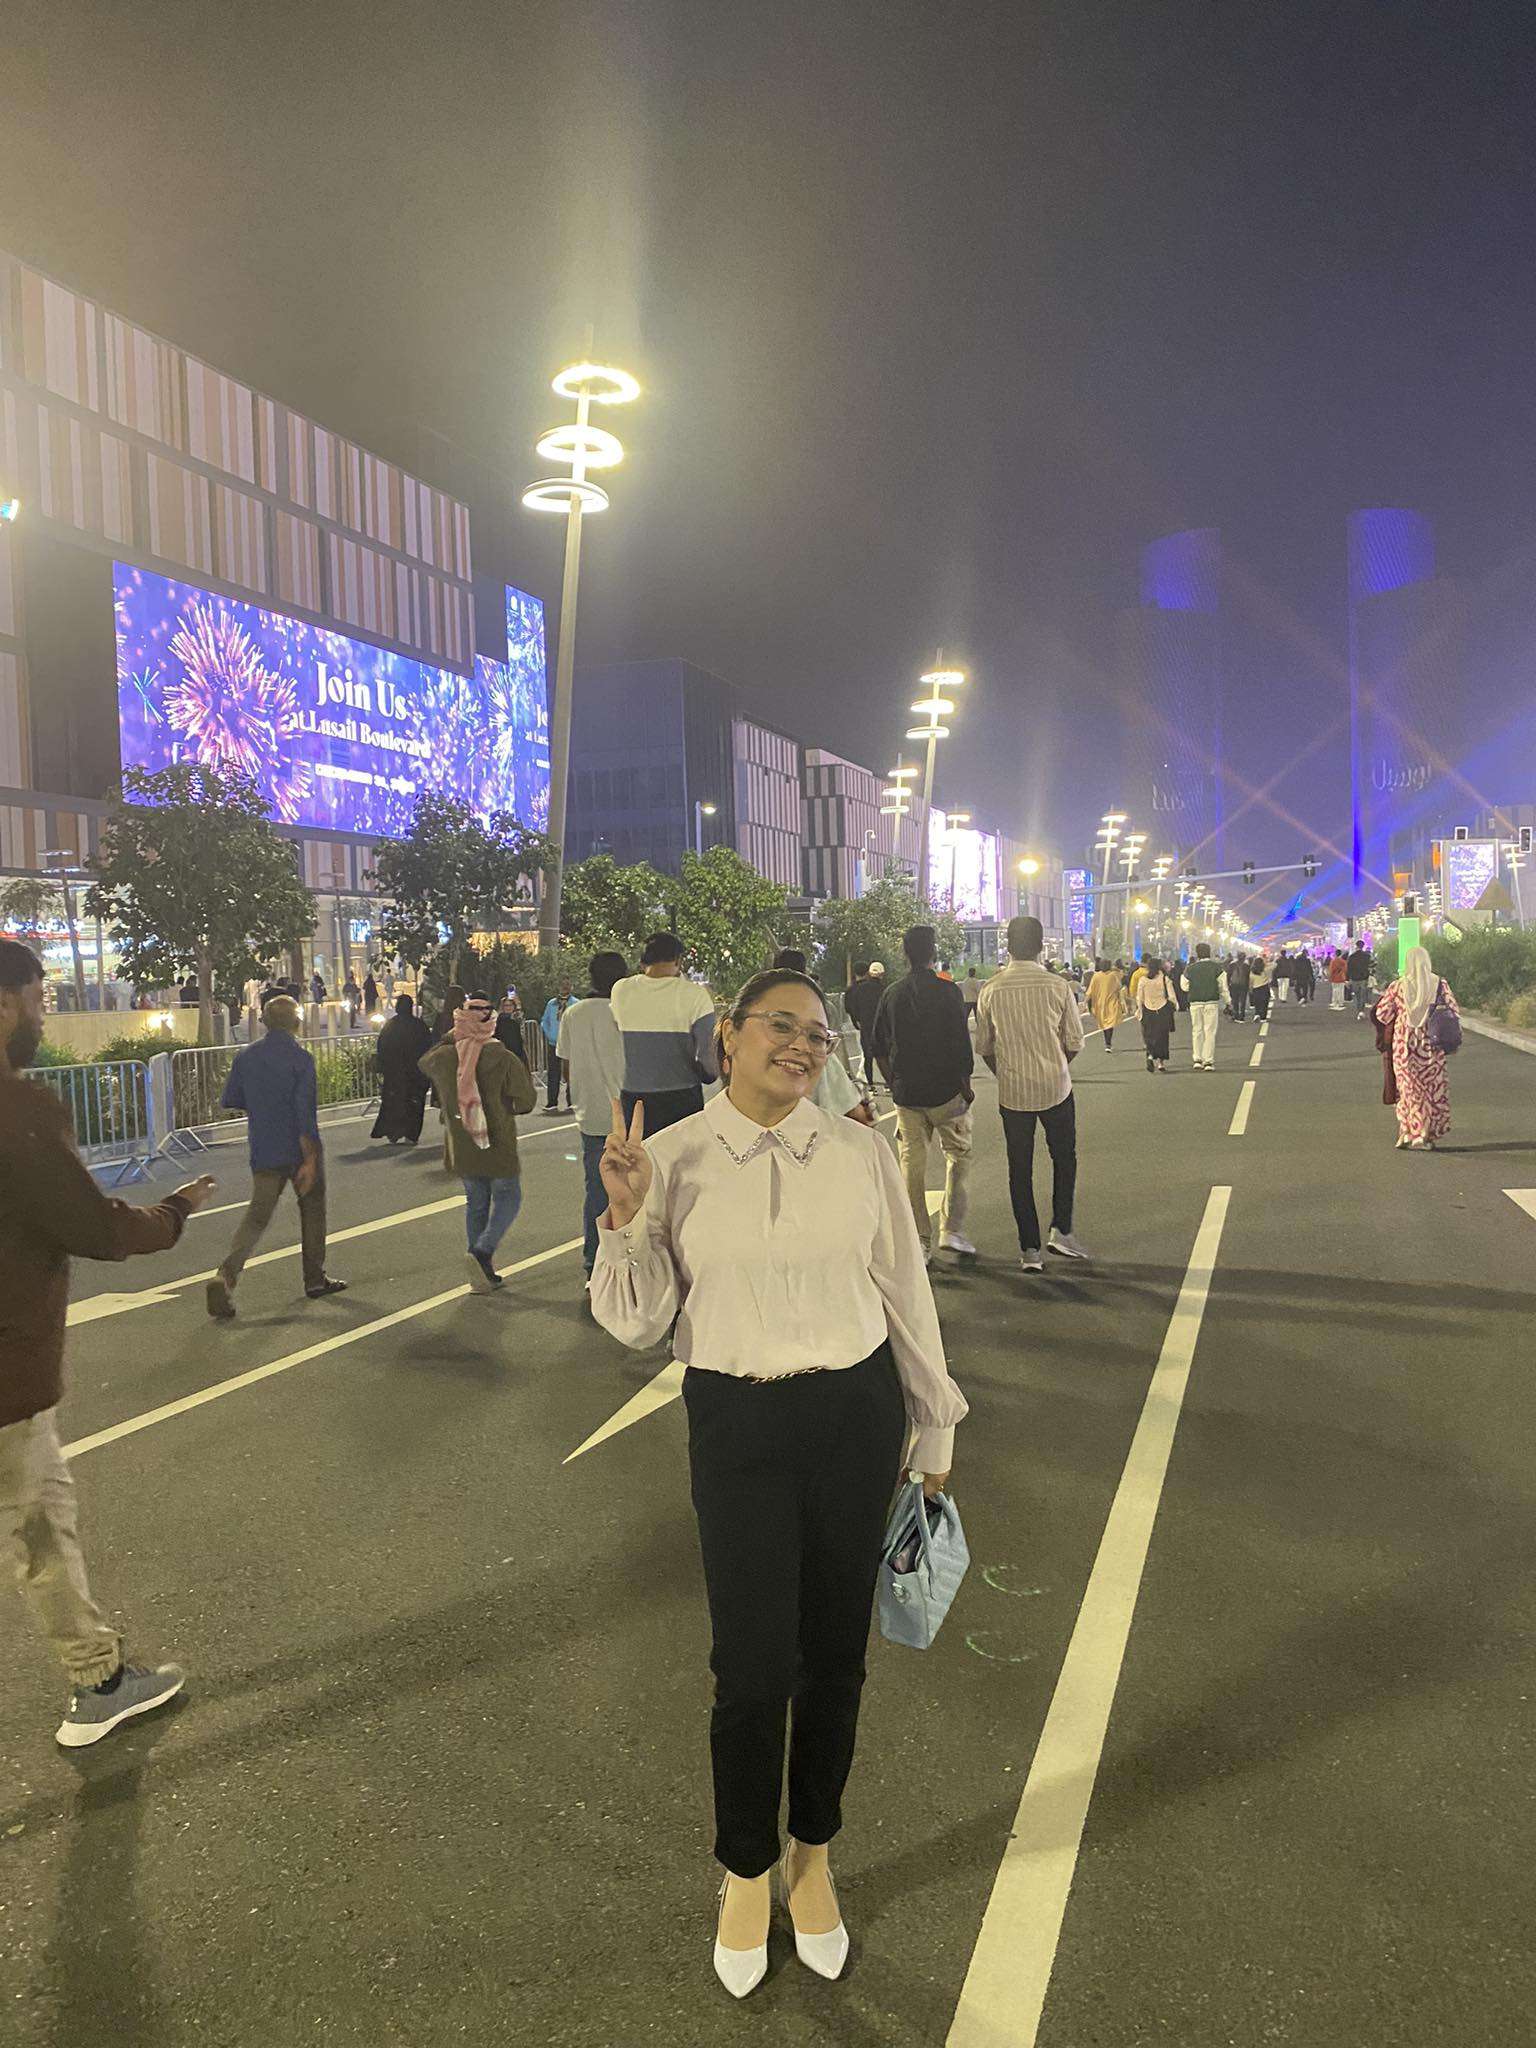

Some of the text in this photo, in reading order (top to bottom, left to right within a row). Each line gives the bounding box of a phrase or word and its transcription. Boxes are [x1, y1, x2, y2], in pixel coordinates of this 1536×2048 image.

[316, 661, 408, 721] Join Us
[287, 709, 432, 759] at Lusail Boulevard
